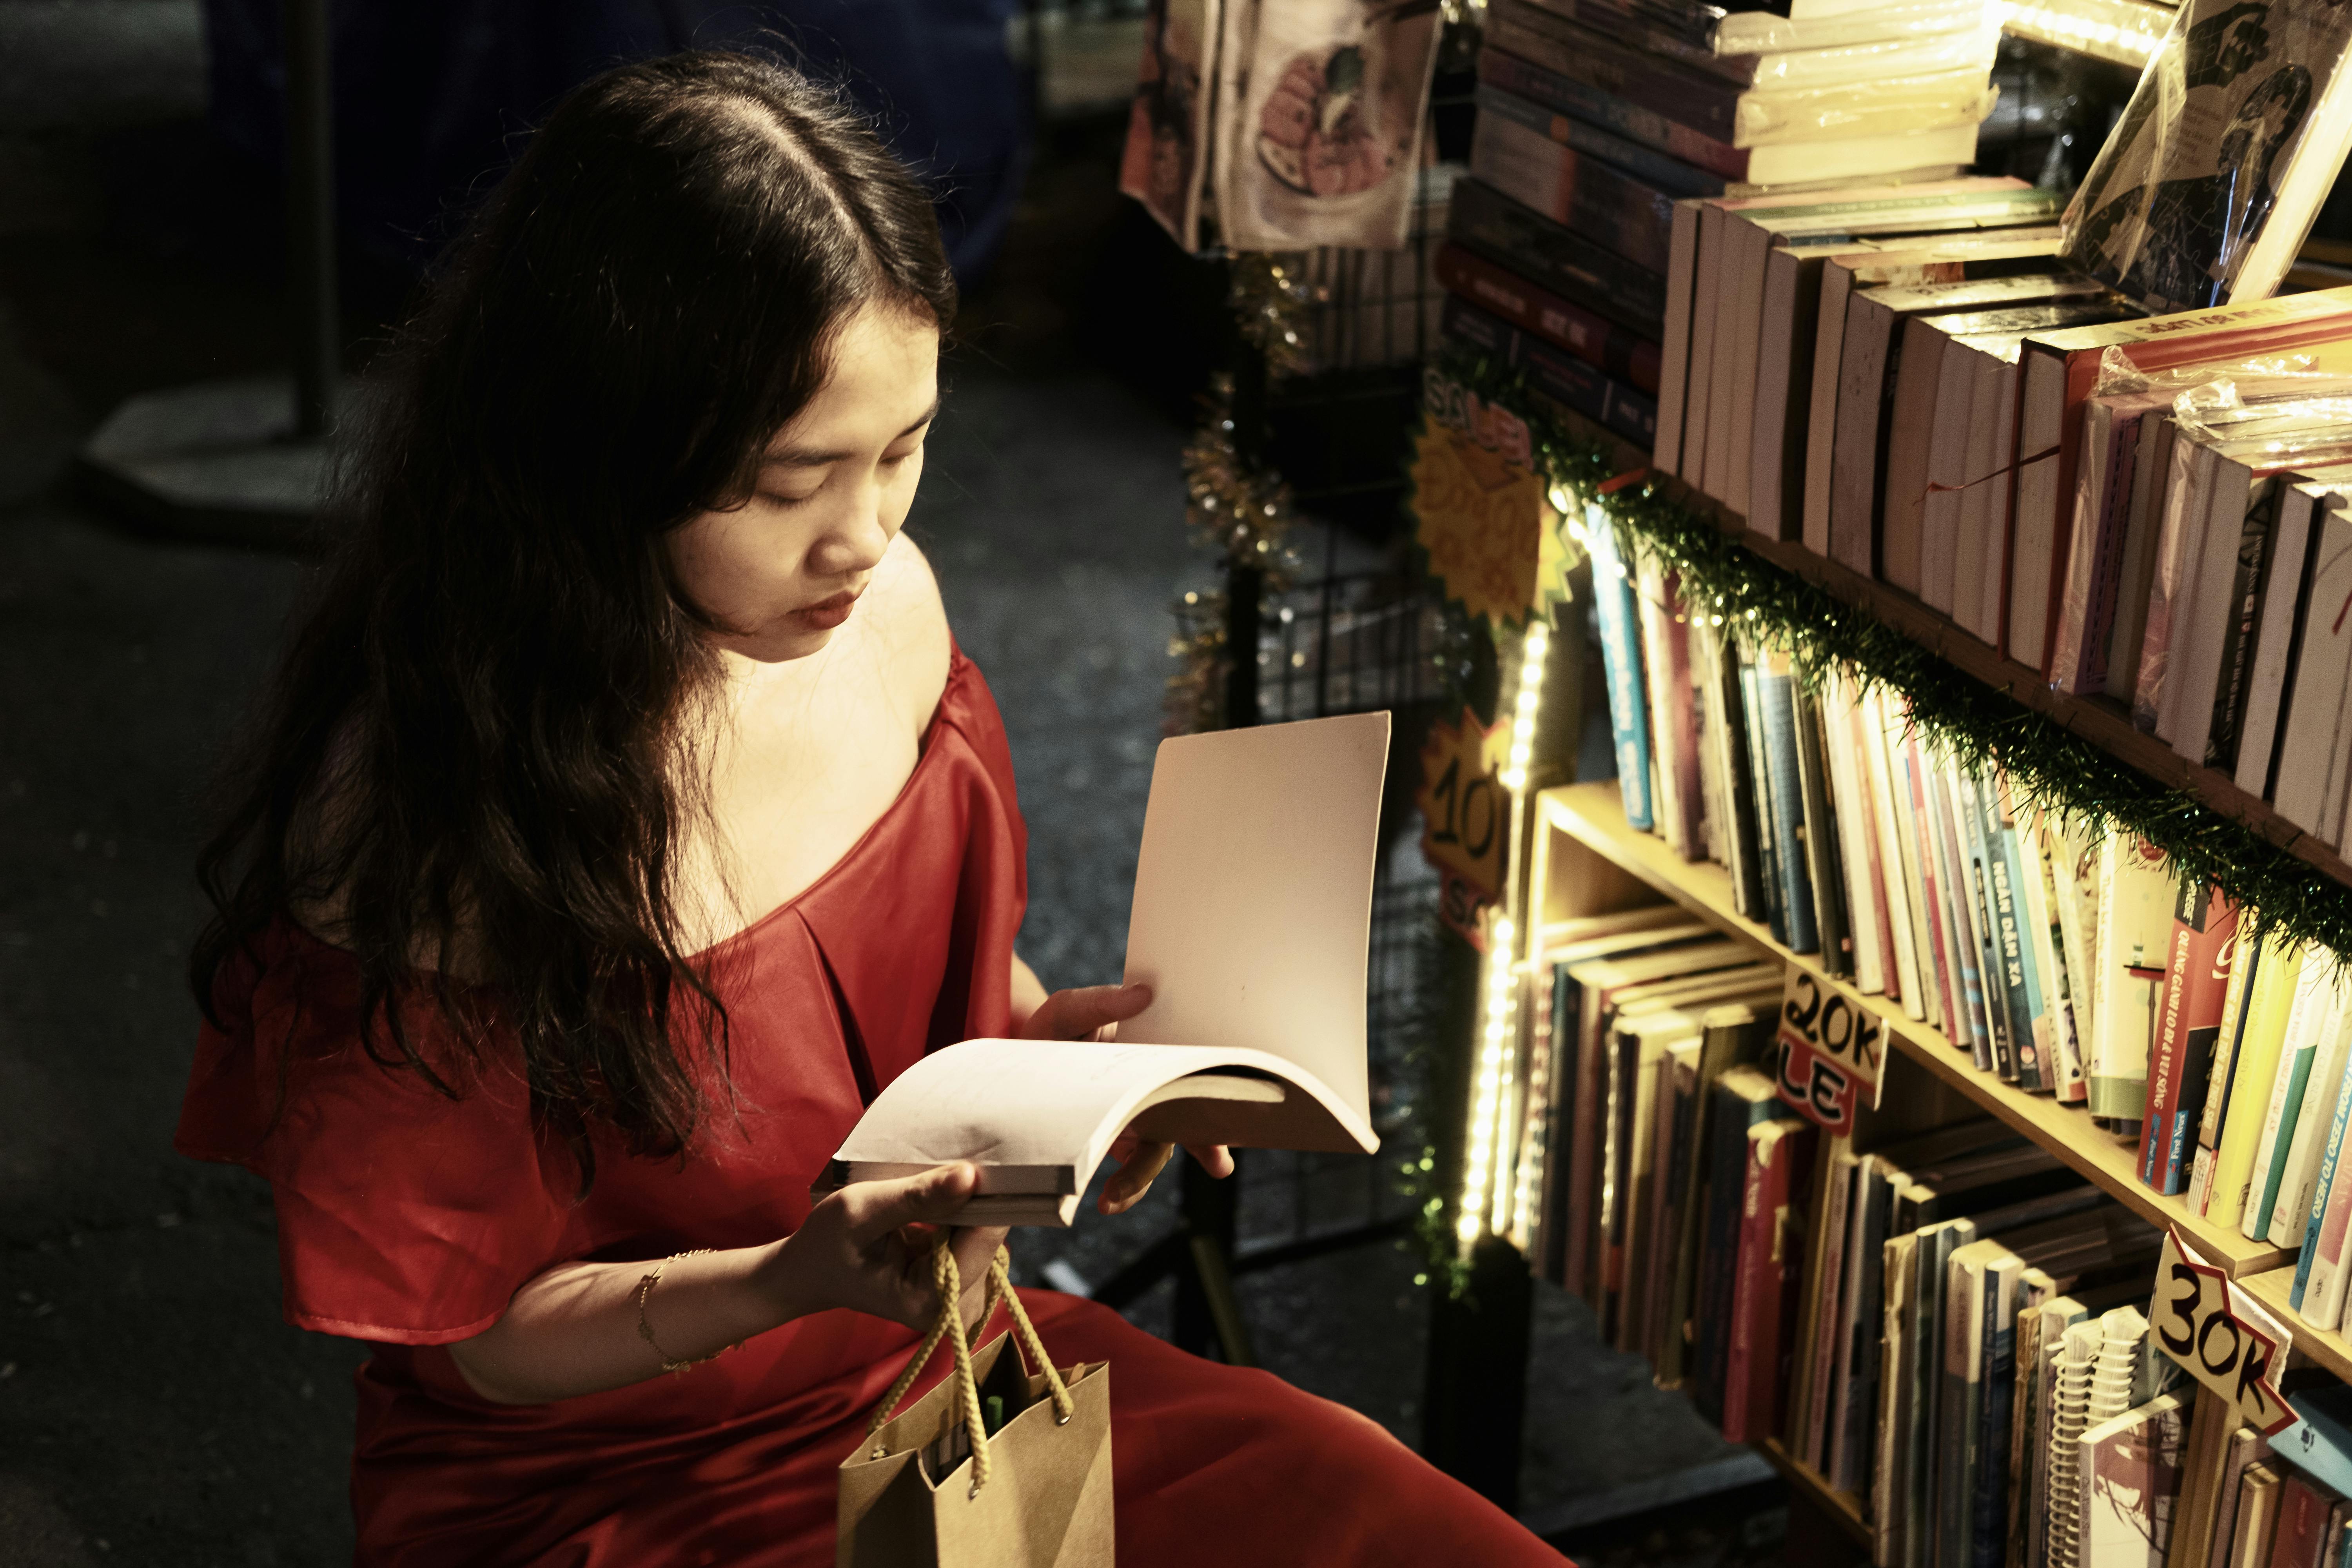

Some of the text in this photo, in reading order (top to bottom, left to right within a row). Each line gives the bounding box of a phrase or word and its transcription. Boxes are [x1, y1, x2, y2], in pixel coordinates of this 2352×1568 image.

[1993, 861, 2011, 913] NGÀN
[2008, 961, 2022, 986] XA
[1786, 974, 1878, 1069] 20K
[2166, 1009, 2177, 1028] LO
[2164, 1027, 2174, 1044] ĐI
[2162, 1042, 2172, 1053] &
[2159, 1055, 2171, 1076] VUI
[2337, 1076, 2352, 1118] FROM
[2203, 1108, 2214, 1129] SAU
[2328, 1117, 2343, 1157] ZERO
[2170, 1139, 2181, 1159] First
[2322, 1158, 2333, 1179] TO
[2312, 1179, 2328, 1219] HERO
[2159, 1262, 2265, 1415] 30K
